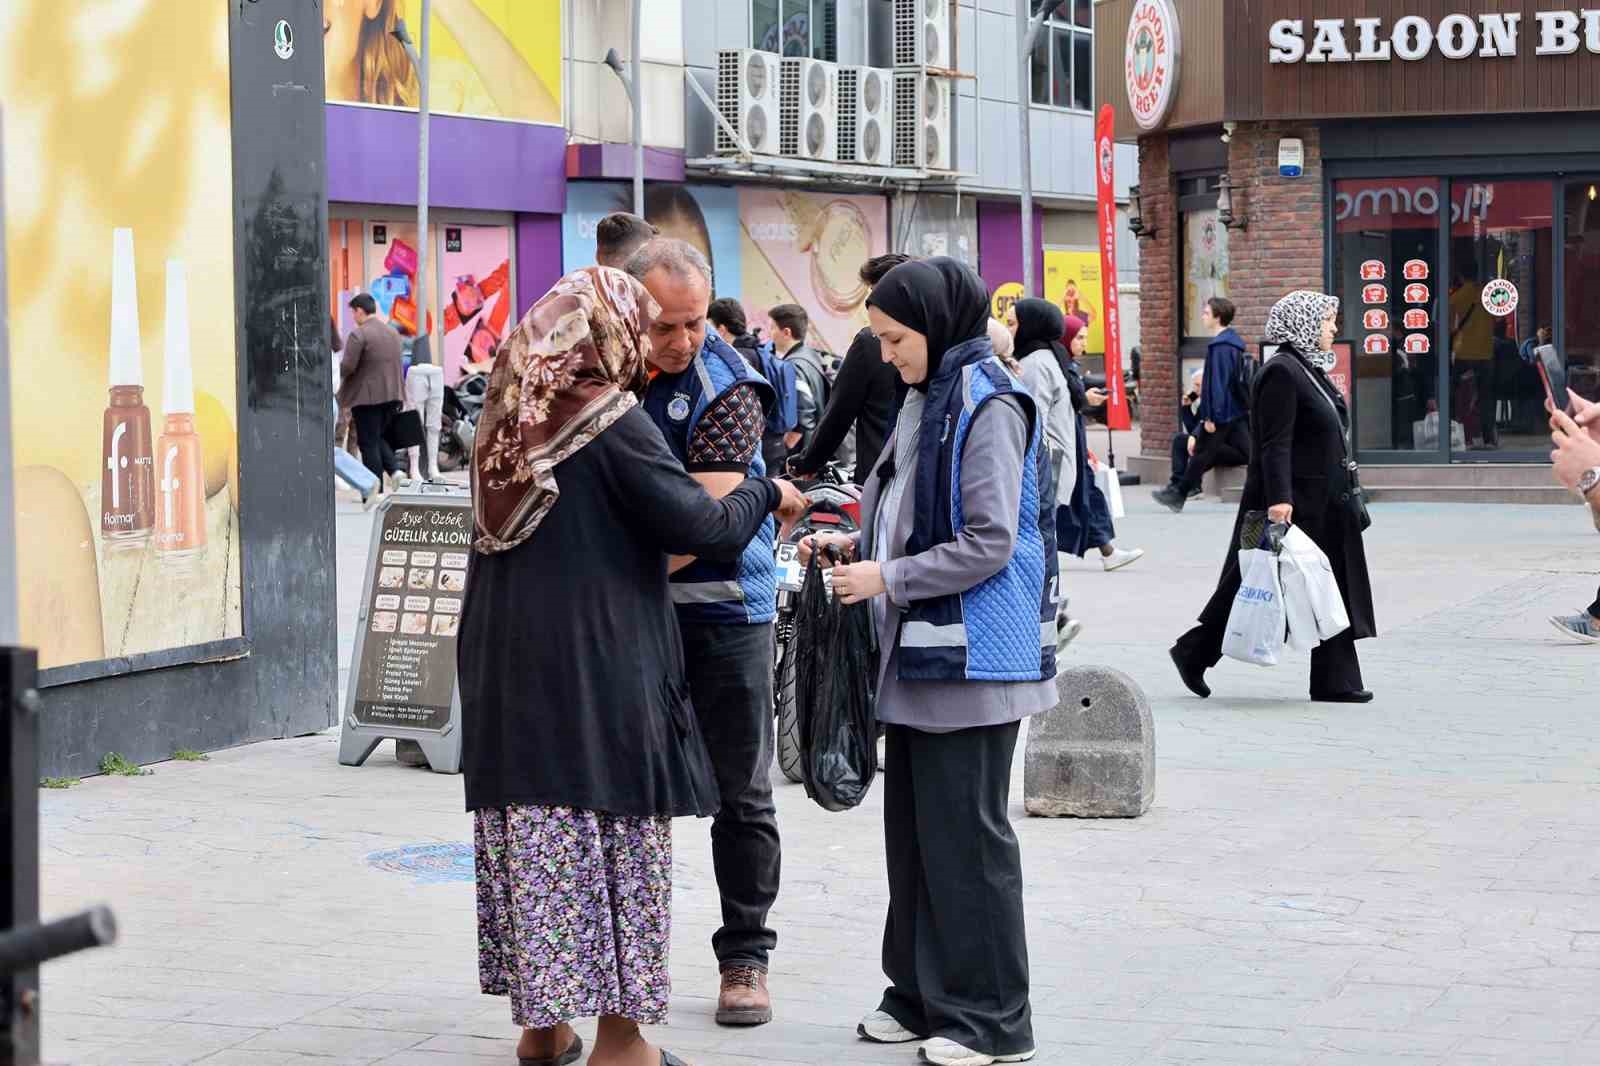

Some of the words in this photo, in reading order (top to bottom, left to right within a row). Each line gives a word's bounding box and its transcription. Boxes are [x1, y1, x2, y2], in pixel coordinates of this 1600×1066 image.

[1268, 12, 1521, 63] SALOON
[397, 511, 423, 527] Ayşe
[431, 509, 464, 528] Özbek
[384, 528, 429, 543] GÜZELLİK
